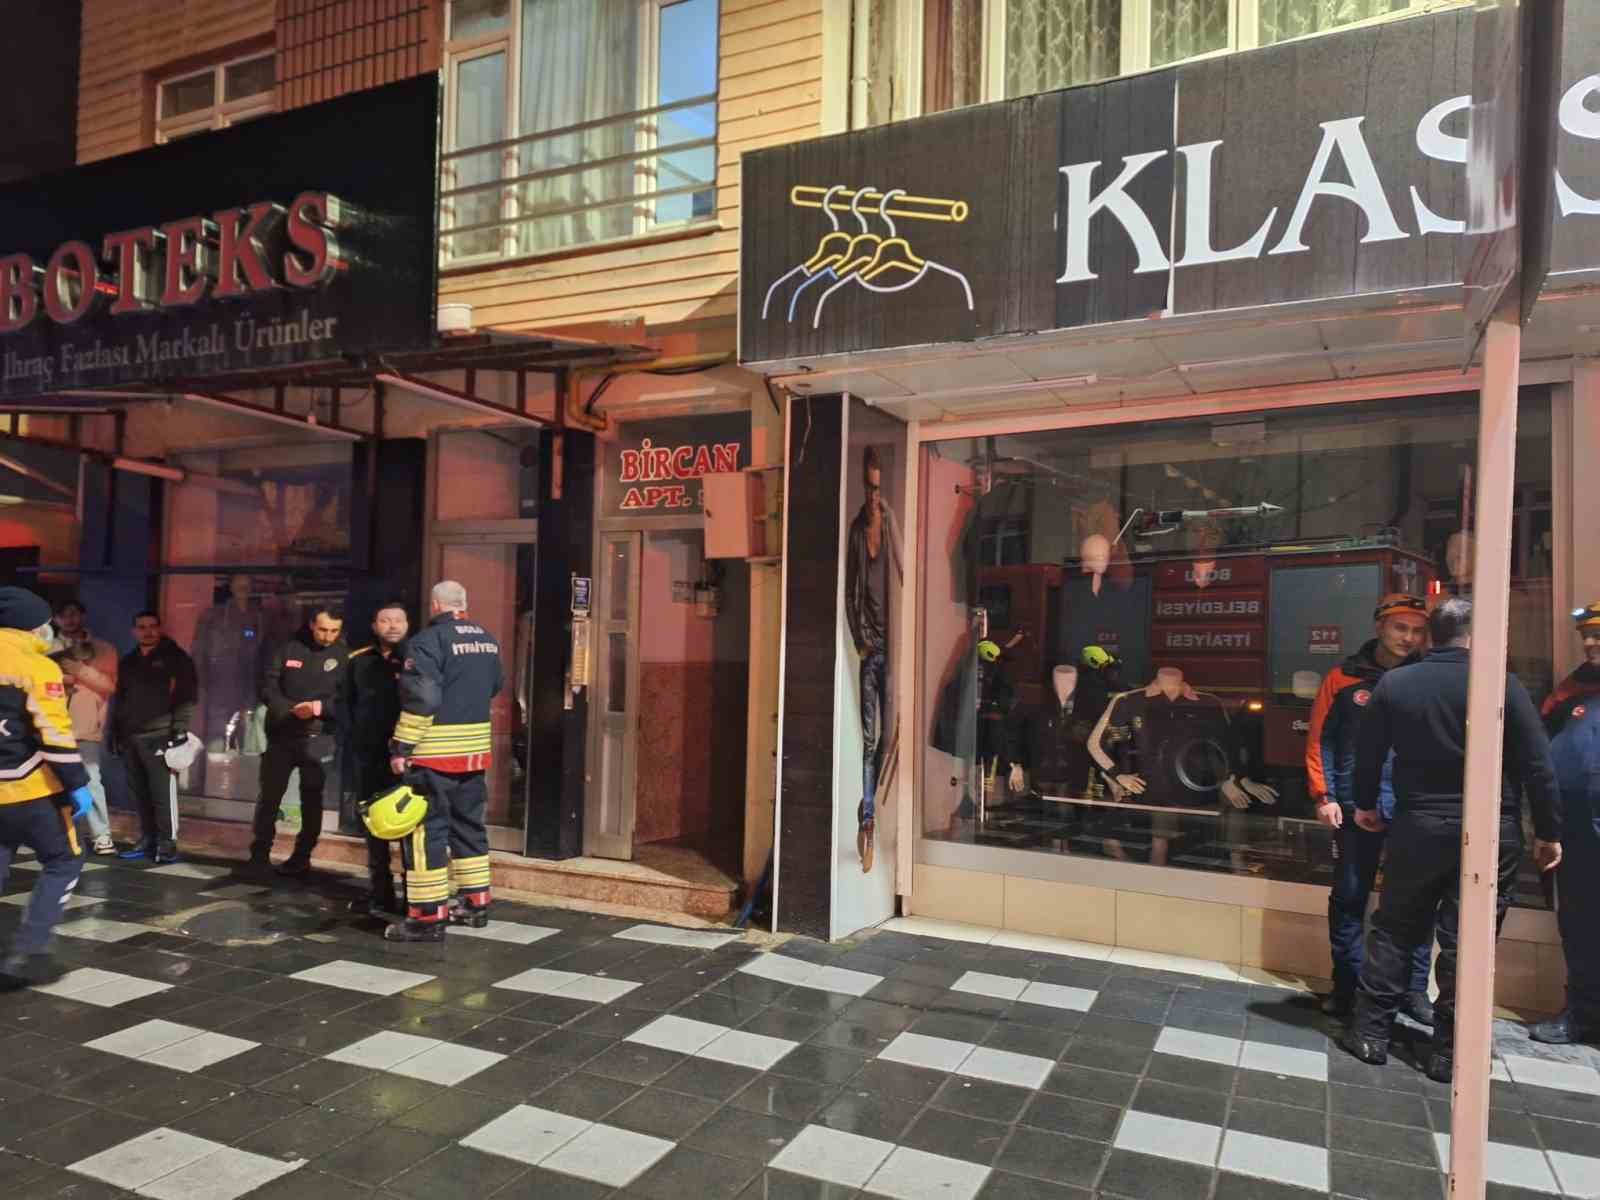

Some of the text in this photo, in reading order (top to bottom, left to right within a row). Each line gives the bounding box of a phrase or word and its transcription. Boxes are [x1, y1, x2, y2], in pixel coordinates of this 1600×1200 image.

[60, 338, 130, 374] Fazlası
[134, 322, 225, 364] Markalı
[233, 307, 338, 351] Ürünler
[619, 438, 740, 481] BİRCAN
[619, 484, 693, 509] APT.
